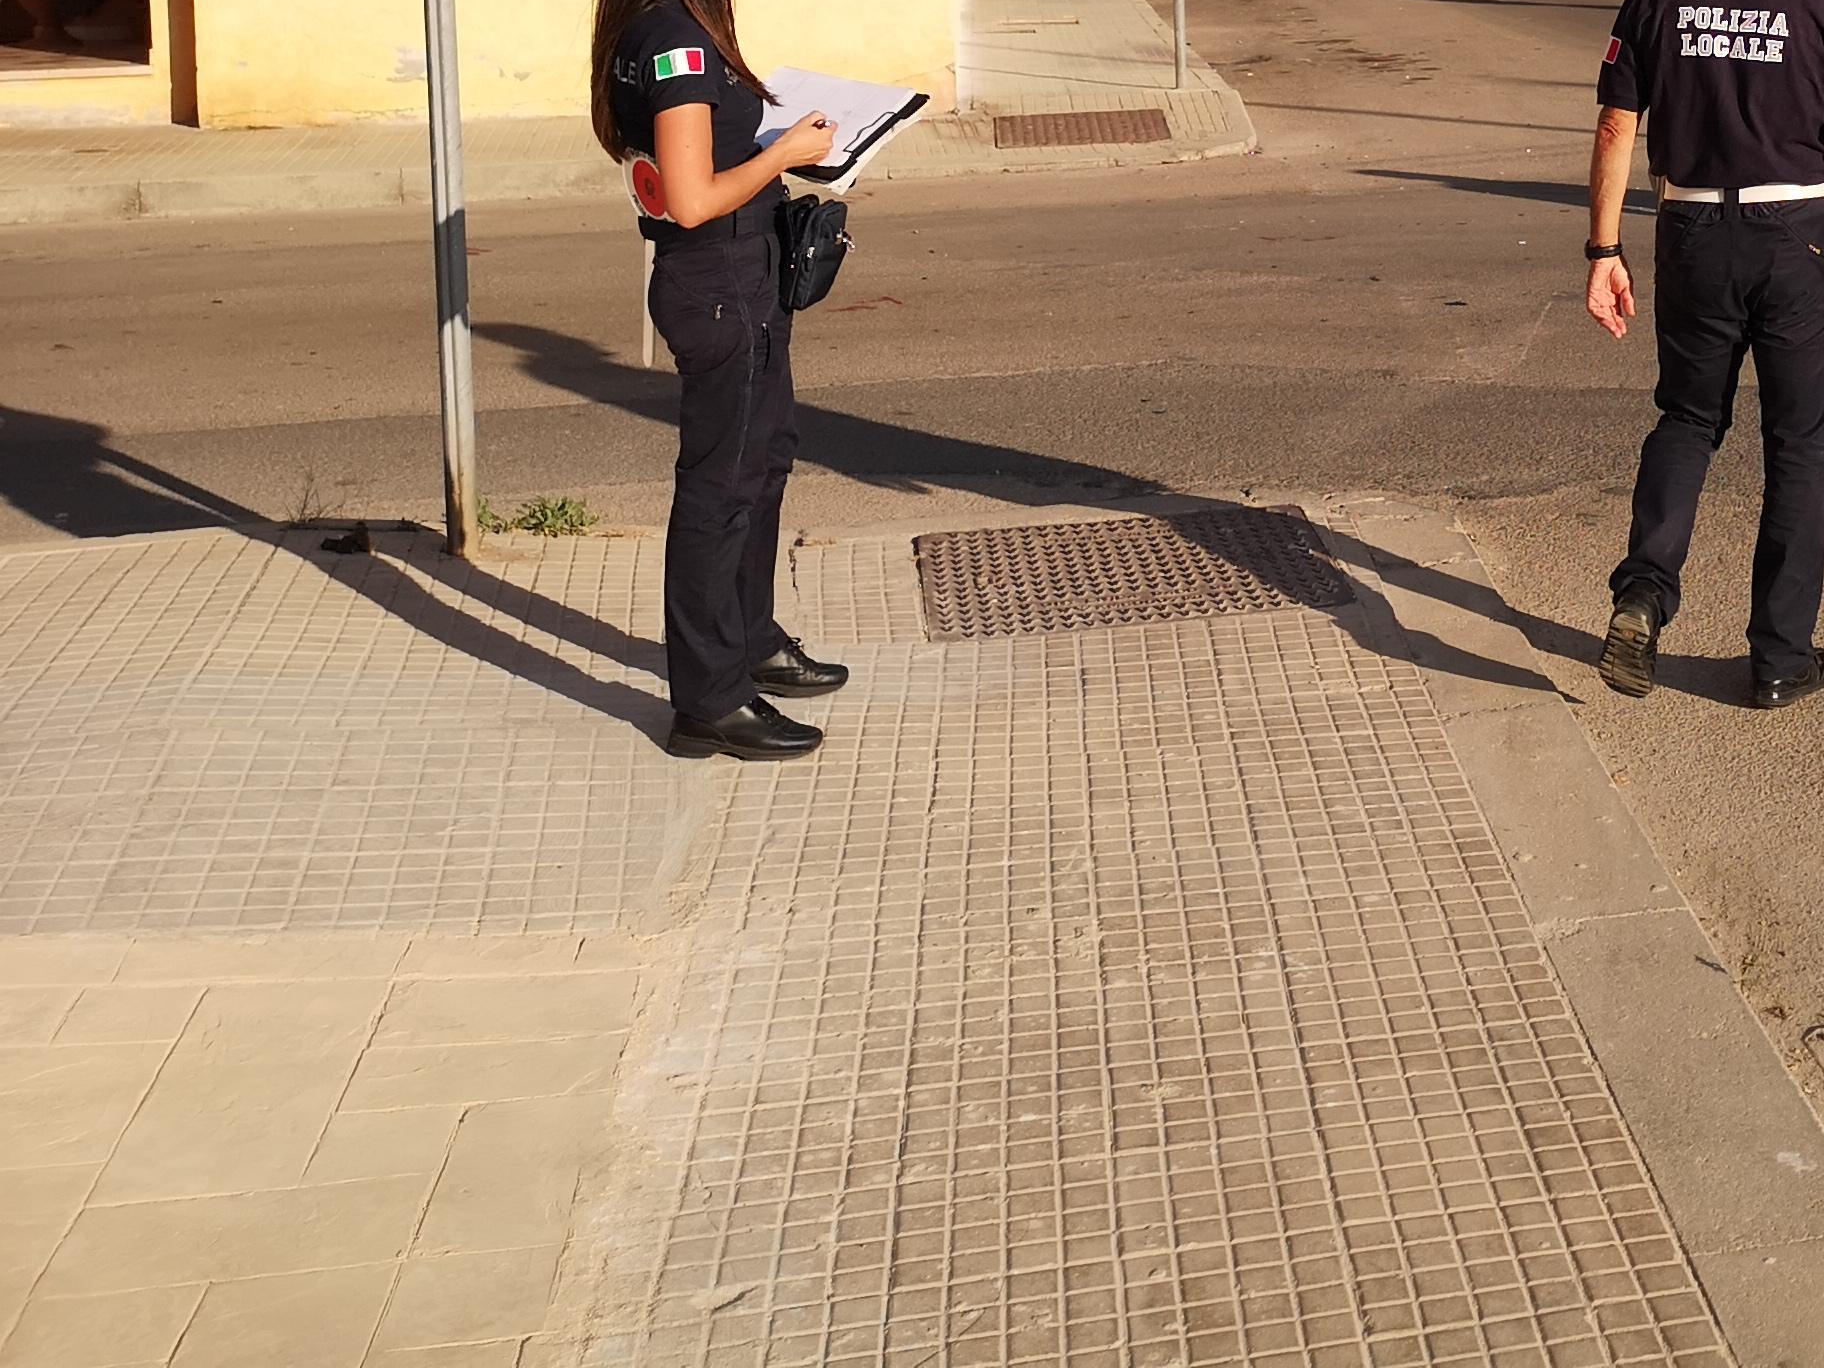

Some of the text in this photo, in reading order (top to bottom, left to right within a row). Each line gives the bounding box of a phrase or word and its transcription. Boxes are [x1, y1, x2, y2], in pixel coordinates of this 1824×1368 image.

[1677, 6, 1789, 37] POLIZIA
[1680, 33, 1784, 63] LOCALE
[613, 56, 637, 85] ALE
